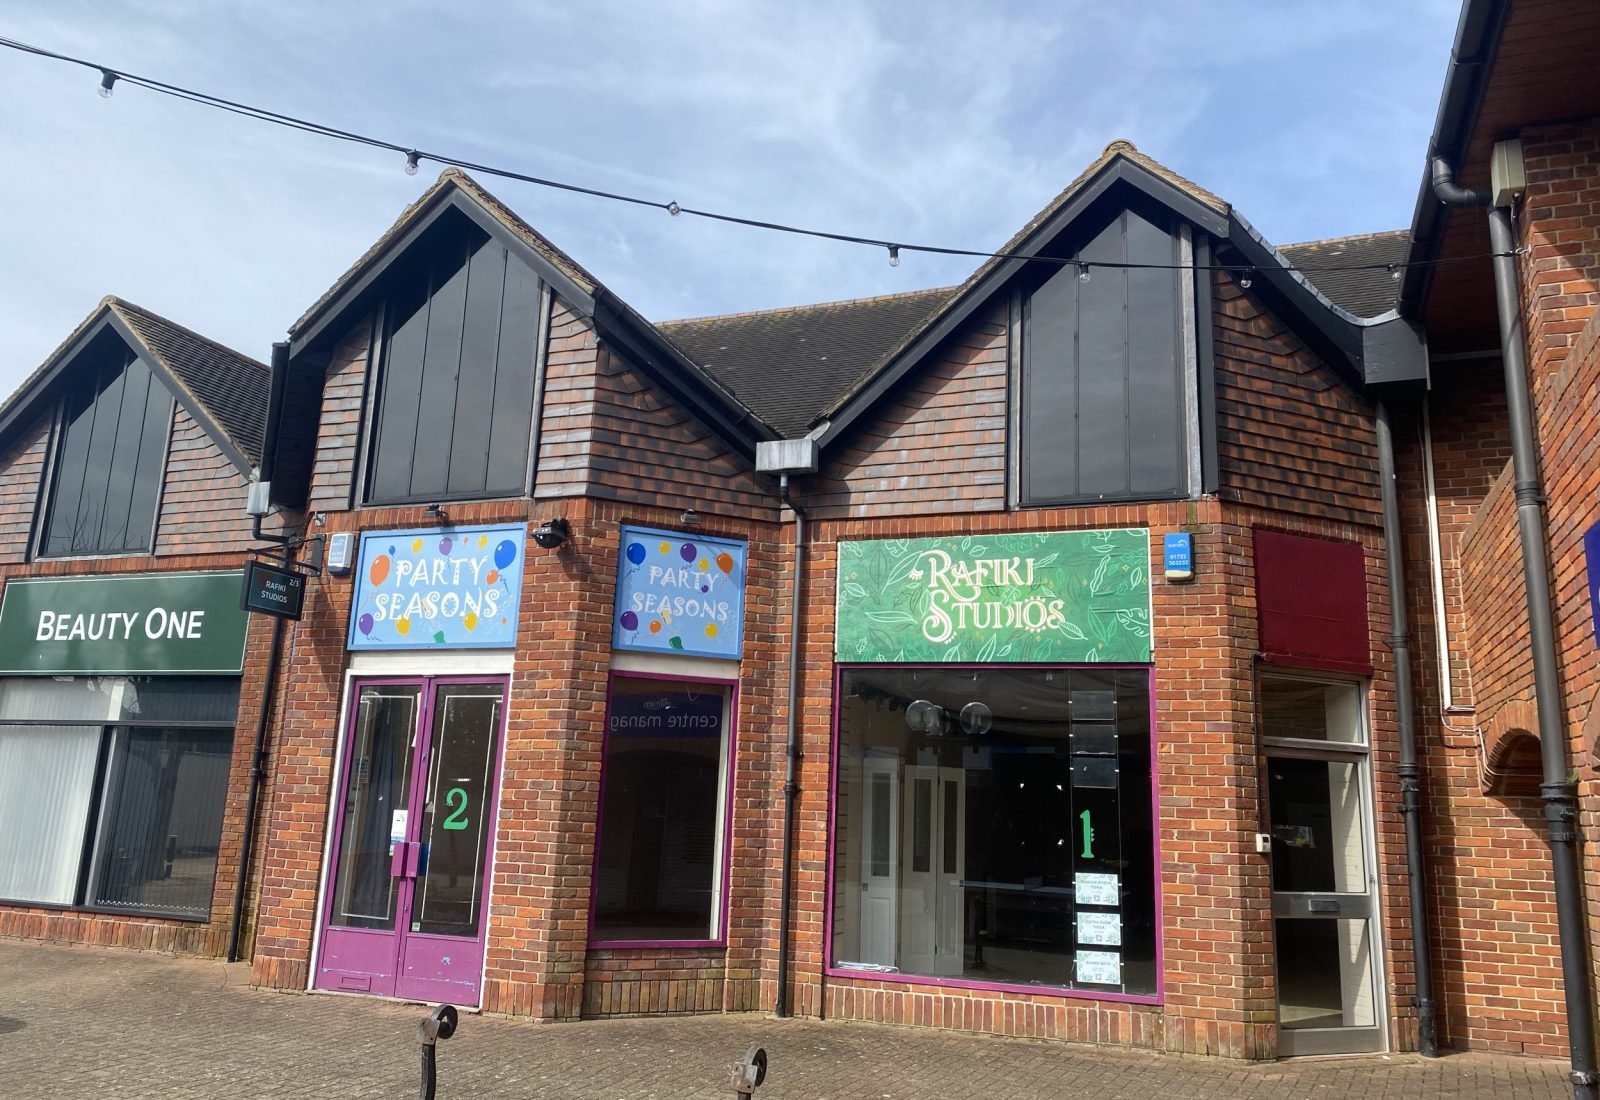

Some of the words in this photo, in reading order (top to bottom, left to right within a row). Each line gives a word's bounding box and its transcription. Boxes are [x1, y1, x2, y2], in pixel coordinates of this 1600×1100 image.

[266, 581, 287, 592] RAFIKI
[289, 579, 299, 587] 2/3
[395, 555, 491, 588] PARTY
[649, 564, 720, 593] PARTY
[914, 549, 1036, 602] RAFIKI
[261, 591, 288, 603] STUDIOS
[373, 587, 501, 622] SEASONS
[631, 592, 730, 622] SEASONS
[36, 610, 140, 641] BEAUTY
[144, 607, 205, 640] ONE
[922, 588, 1064, 644] STUDIOS
[443, 787, 469, 831] 2
[1079, 809, 1095, 859] 1
